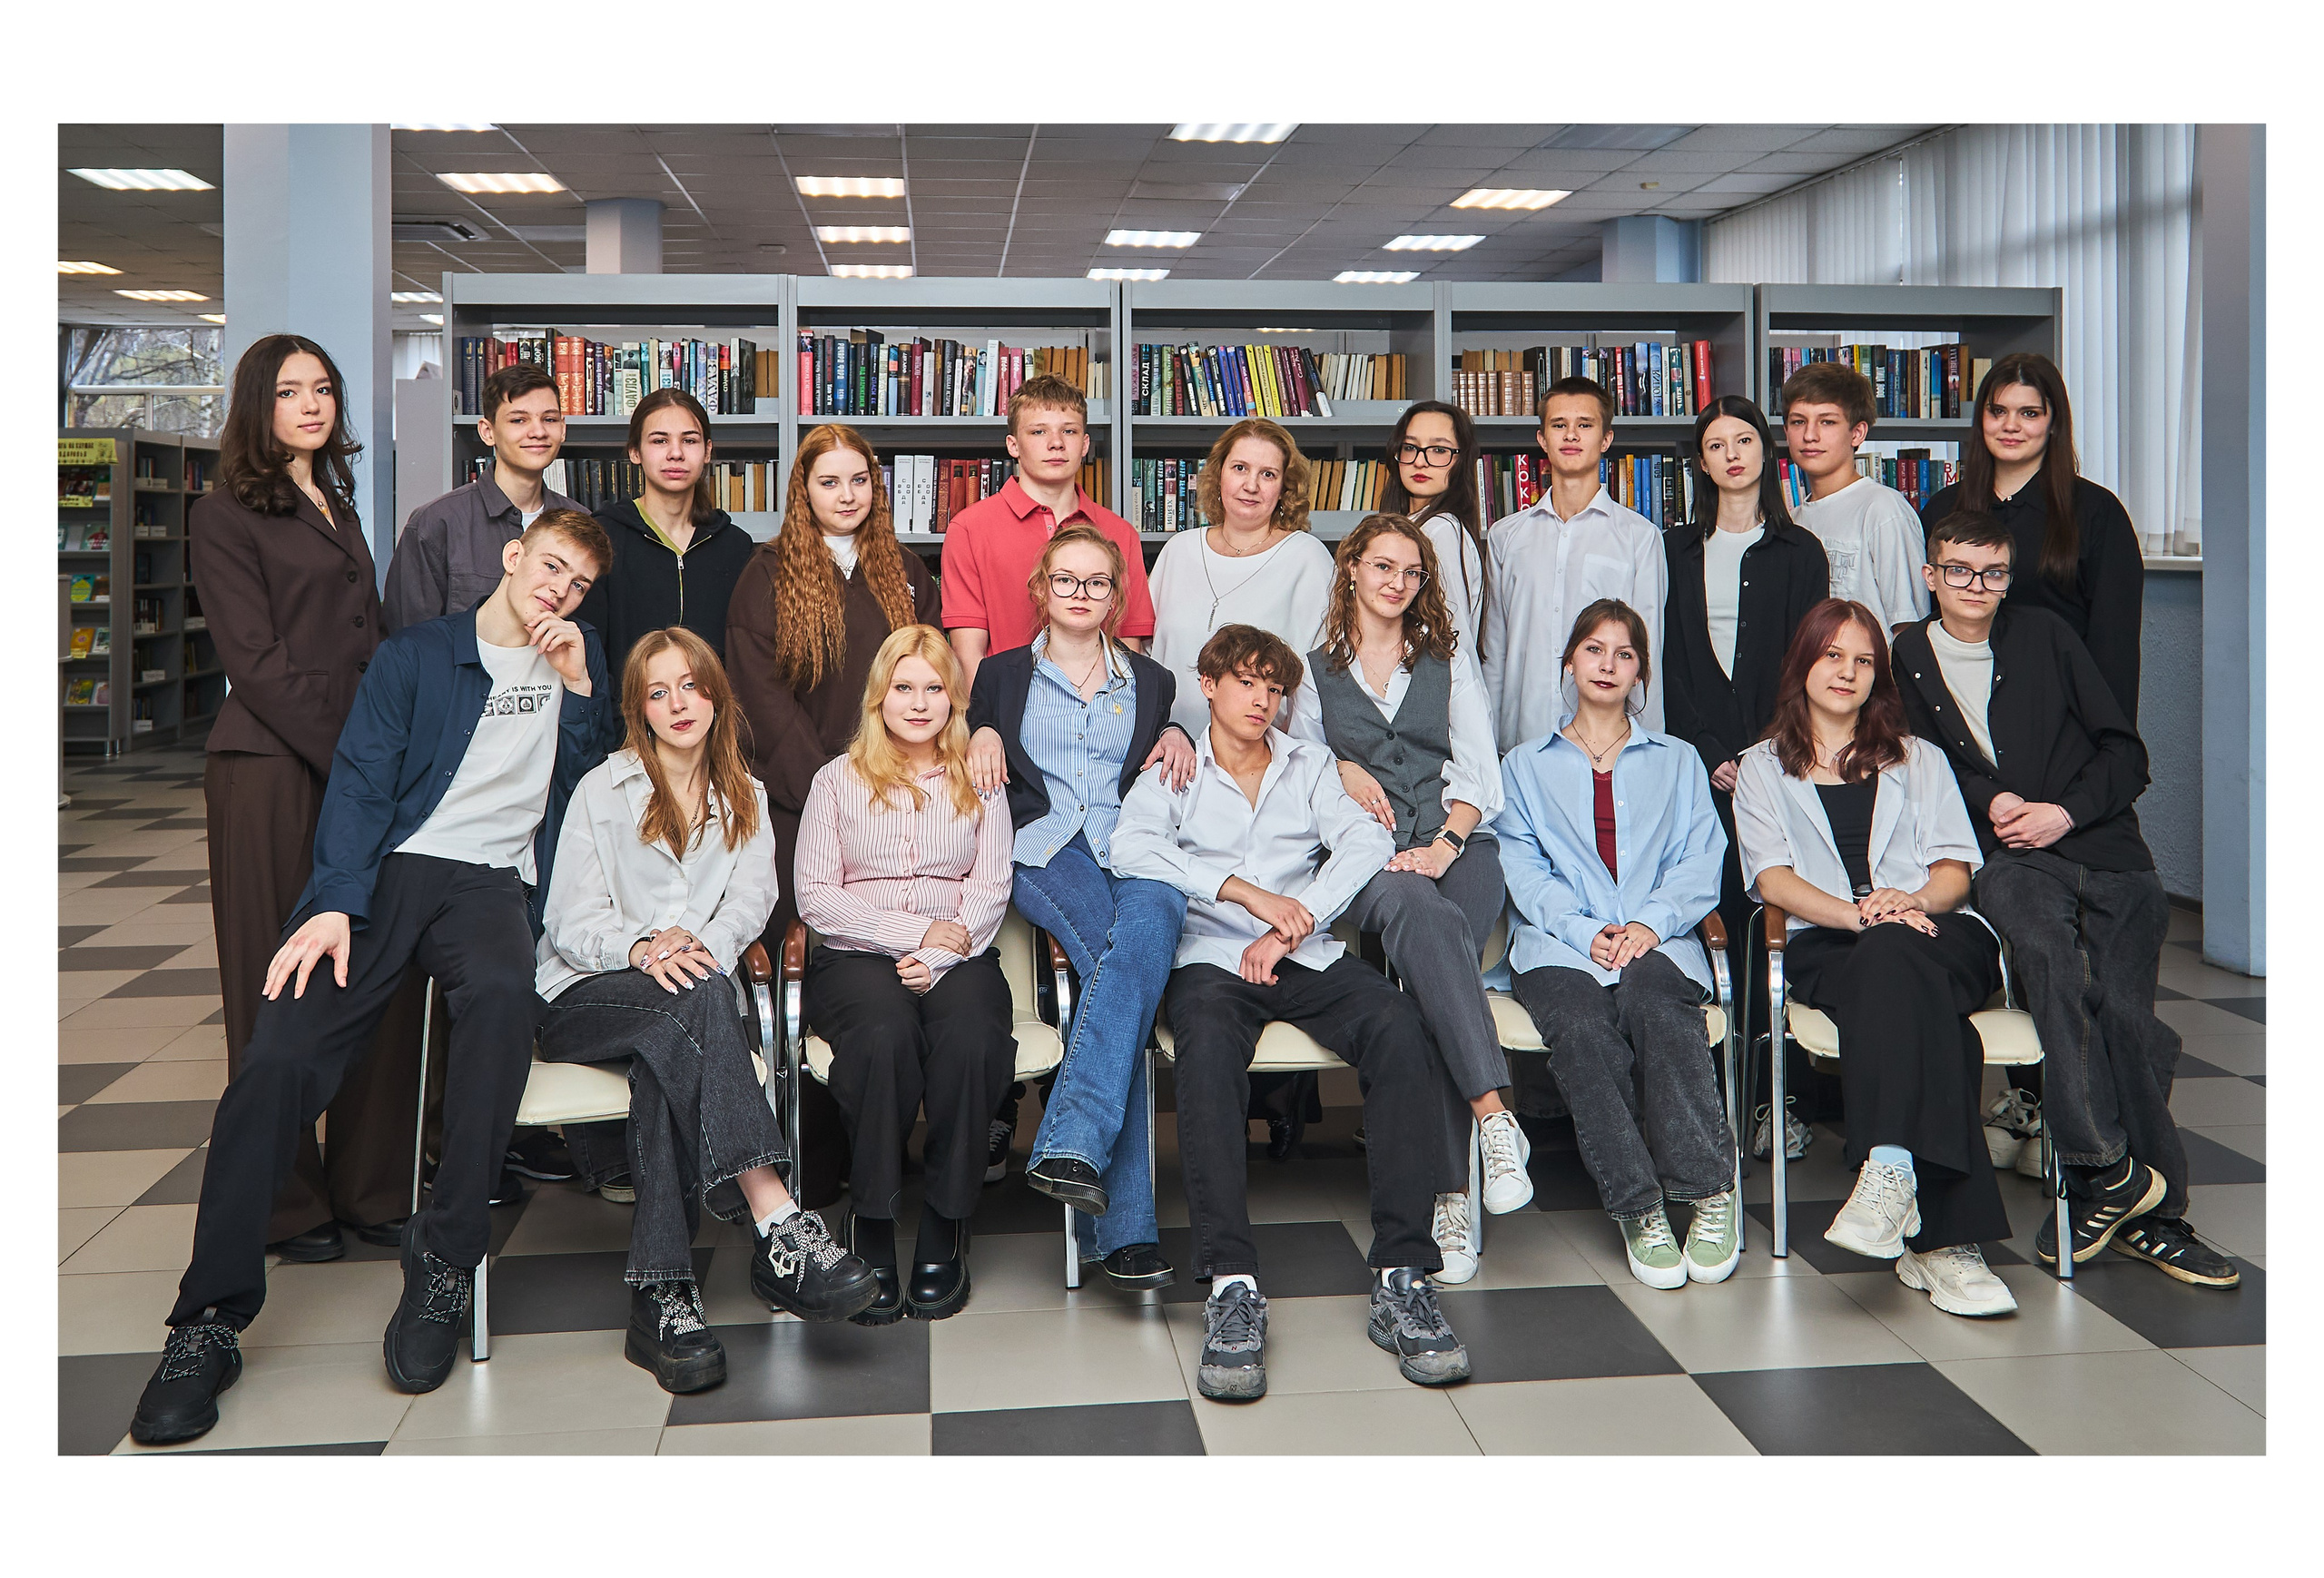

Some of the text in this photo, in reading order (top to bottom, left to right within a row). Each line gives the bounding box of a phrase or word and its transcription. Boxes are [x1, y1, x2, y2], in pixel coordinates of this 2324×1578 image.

[625, 378, 637, 408] ФАУЛЗ
[708, 364, 717, 411] ФАУЛЗ
[1141, 361, 1150, 397] СКЛАД
[1652, 370, 1662, 406] УТОПИЯ
